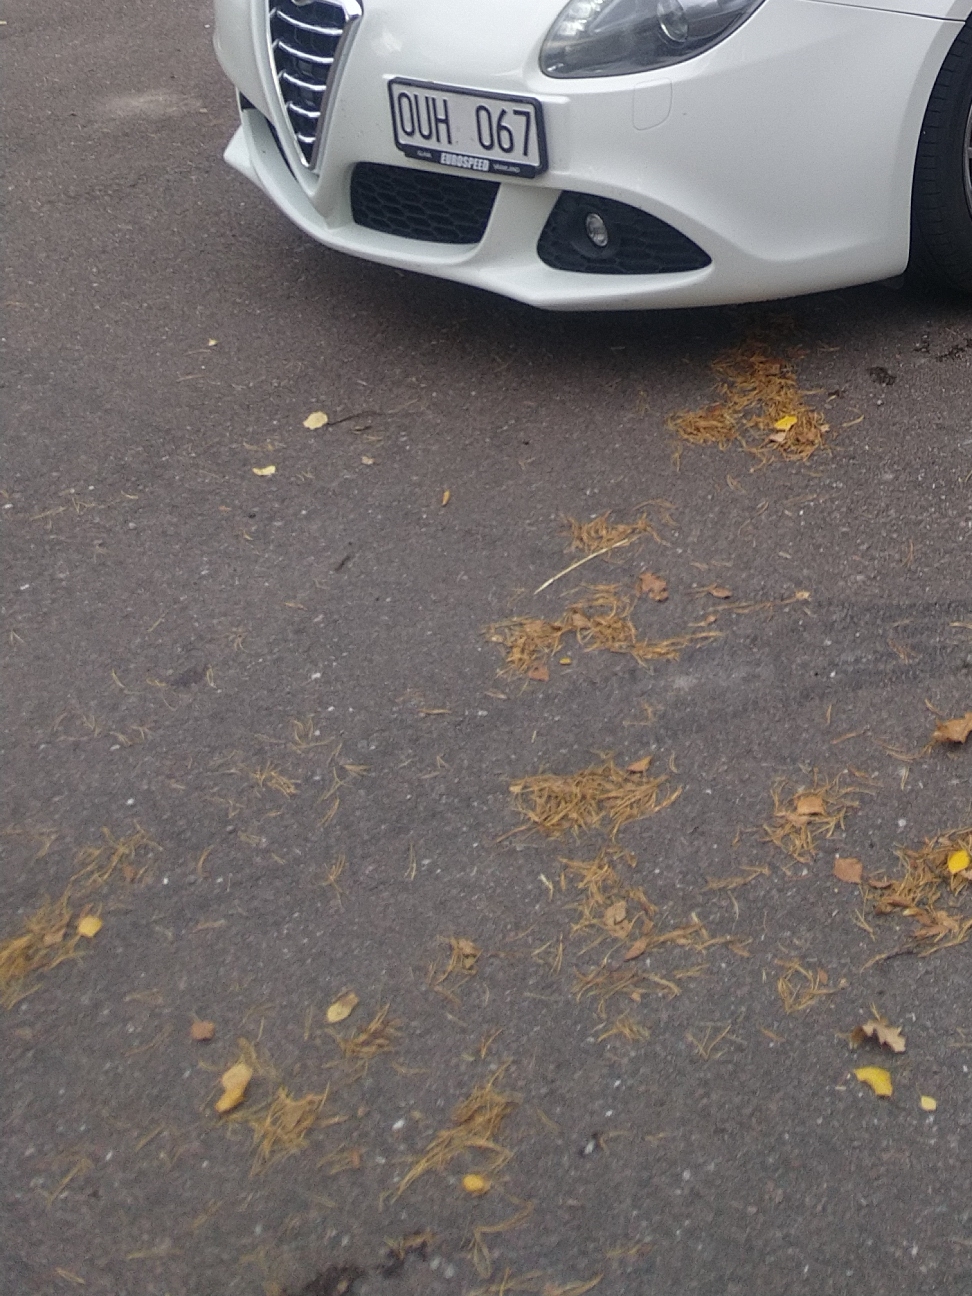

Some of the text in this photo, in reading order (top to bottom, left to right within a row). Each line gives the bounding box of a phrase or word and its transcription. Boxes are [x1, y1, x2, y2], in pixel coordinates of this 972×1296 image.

[397, 91, 531, 157] OUH 067
[440, 152, 490, 172] EUROSPEED
